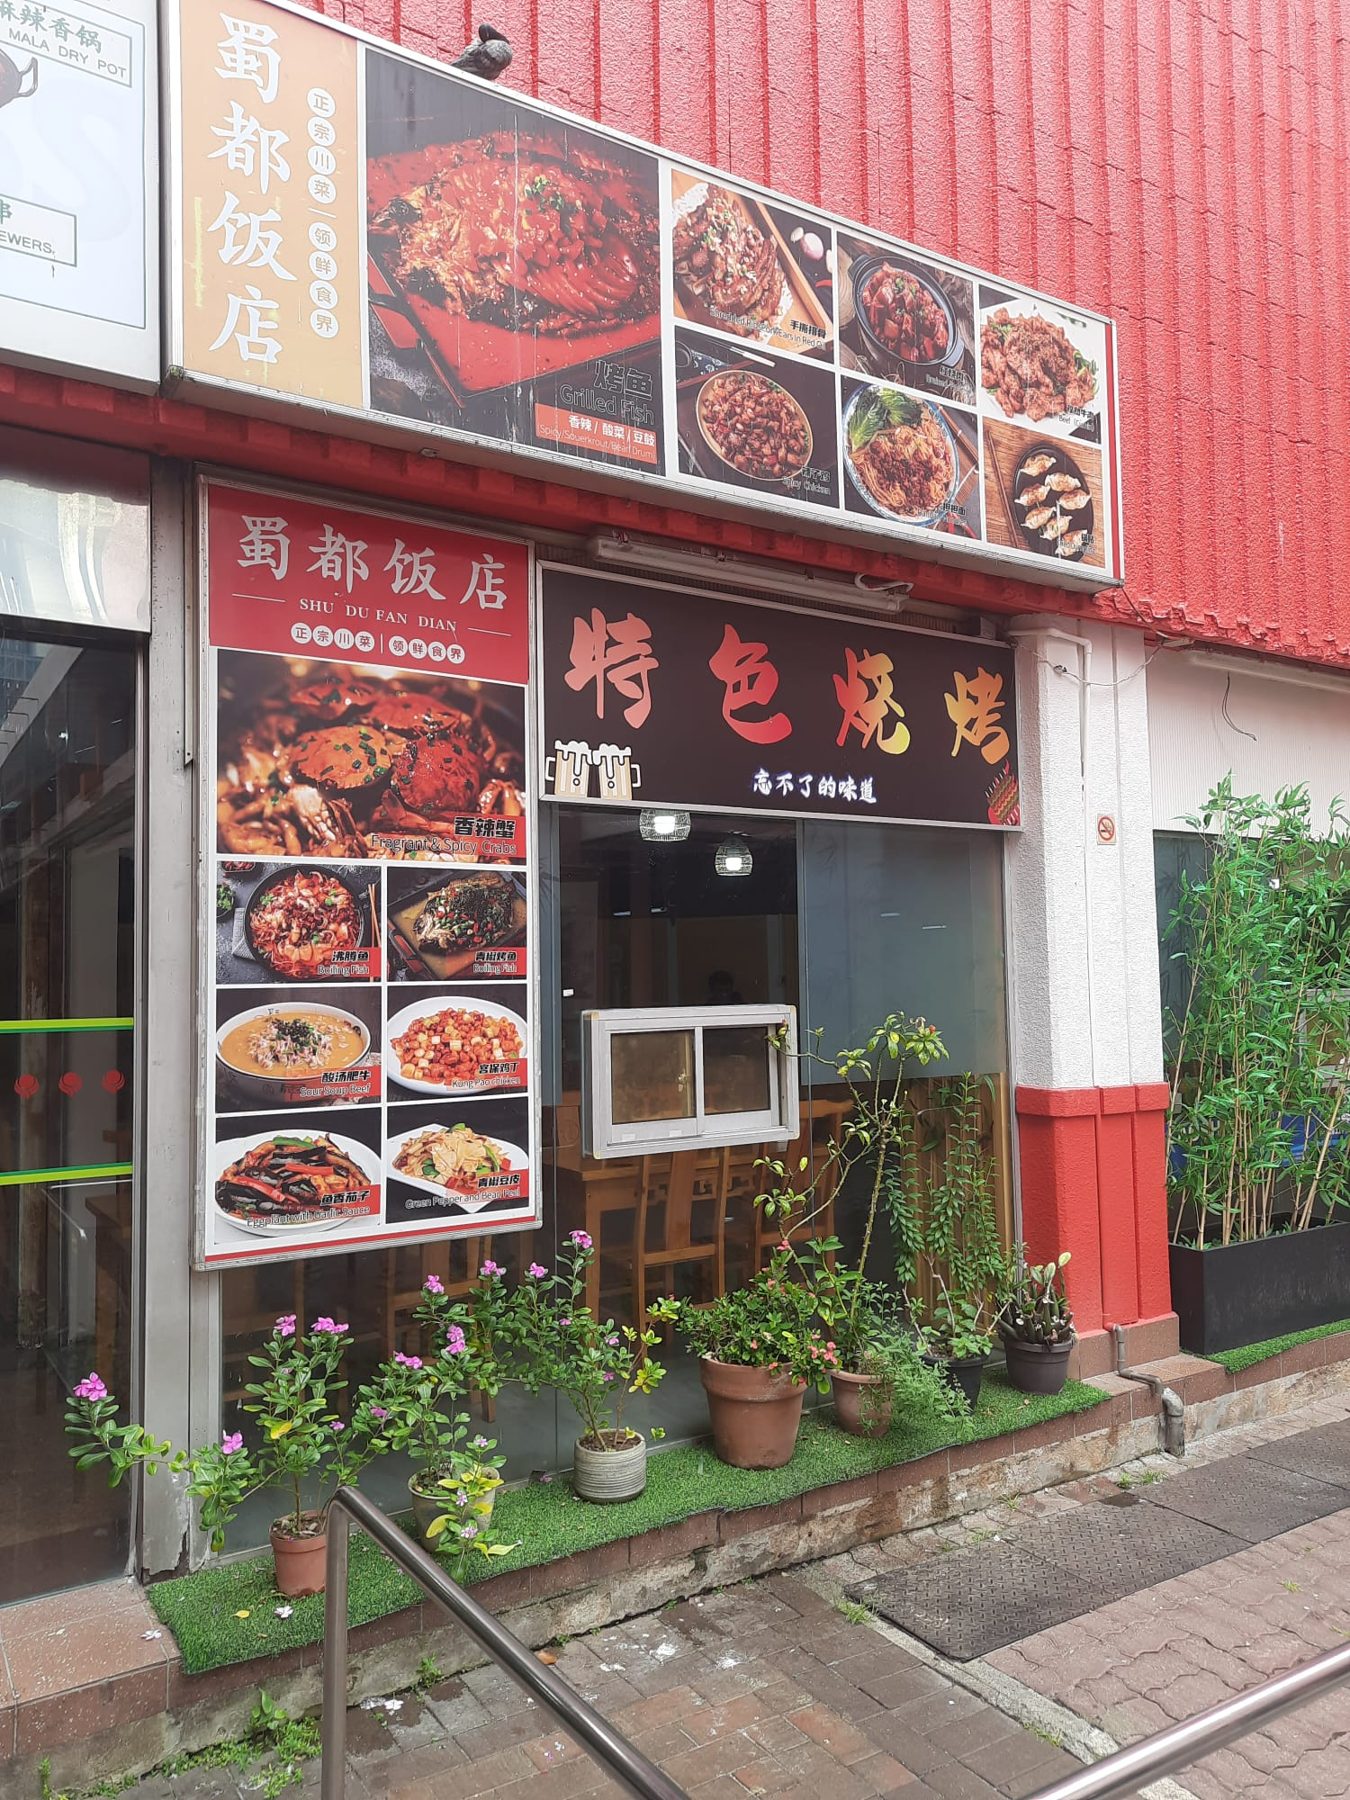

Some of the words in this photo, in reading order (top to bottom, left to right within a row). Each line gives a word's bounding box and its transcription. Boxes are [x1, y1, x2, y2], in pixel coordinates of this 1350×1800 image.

[9, 28, 50, 52] MALA
[58, 45, 89, 64] DRY
[97, 59, 127, 78] POT
[311, 91, 332, 201] 正宗川菜
[208, 12, 297, 364] 蜀都饭店
[312, 225, 335, 335] 领鲜食界
[594, 360, 653, 401] 烤鱼
[560, 384, 617, 416] Grilled
[621, 399, 655, 426] Fish
[237, 515, 507, 610] 蜀都饭店
[300, 598, 334, 614] SHU
[345, 604, 369, 619] DU
[376, 609, 408, 625] FAN
[418, 615, 457, 632] DIAN
[293, 624, 373, 649] 正宗川菜
[391, 637, 463, 662] 领鲜食界
[564, 607, 1010, 765] 特色烧烤
[753, 767, 877, 804] 忘不了的味道
[454, 816, 515, 839] 香辣蟹
[371, 834, 429, 853] Fragrant
[431, 838, 441, 851] &
[444, 838, 477, 855] Spicy
[482, 840, 517, 854] Crabs
[317, 965, 350, 977] Boiling
[350, 963, 369, 975] Fish
[321, 1070, 371, 1084] 酸汤肥牛
[479, 1062, 519, 1075] 宫保鸡丁
[300, 1087, 323, 1097] Sour
[324, 1085, 348, 1097] Soup
[350, 1083, 371, 1094] Beef
[452, 1079, 473, 1089] Kung
[475, 1078, 491, 1086] Pao
[478, 1174, 520, 1189] 青椒豆皮
[320, 1190, 371, 1207] 鱼香茄子
[405, 1198, 432, 1210] Green
[432, 1193, 462, 1208] Pepper
[464, 1193, 480, 1202] and
[247, 1213, 291, 1229] Eggplant
[292, 1211, 311, 1222] with
[312, 1208, 340, 1220] Garlic
[342, 1205, 371, 1217] Sauce
